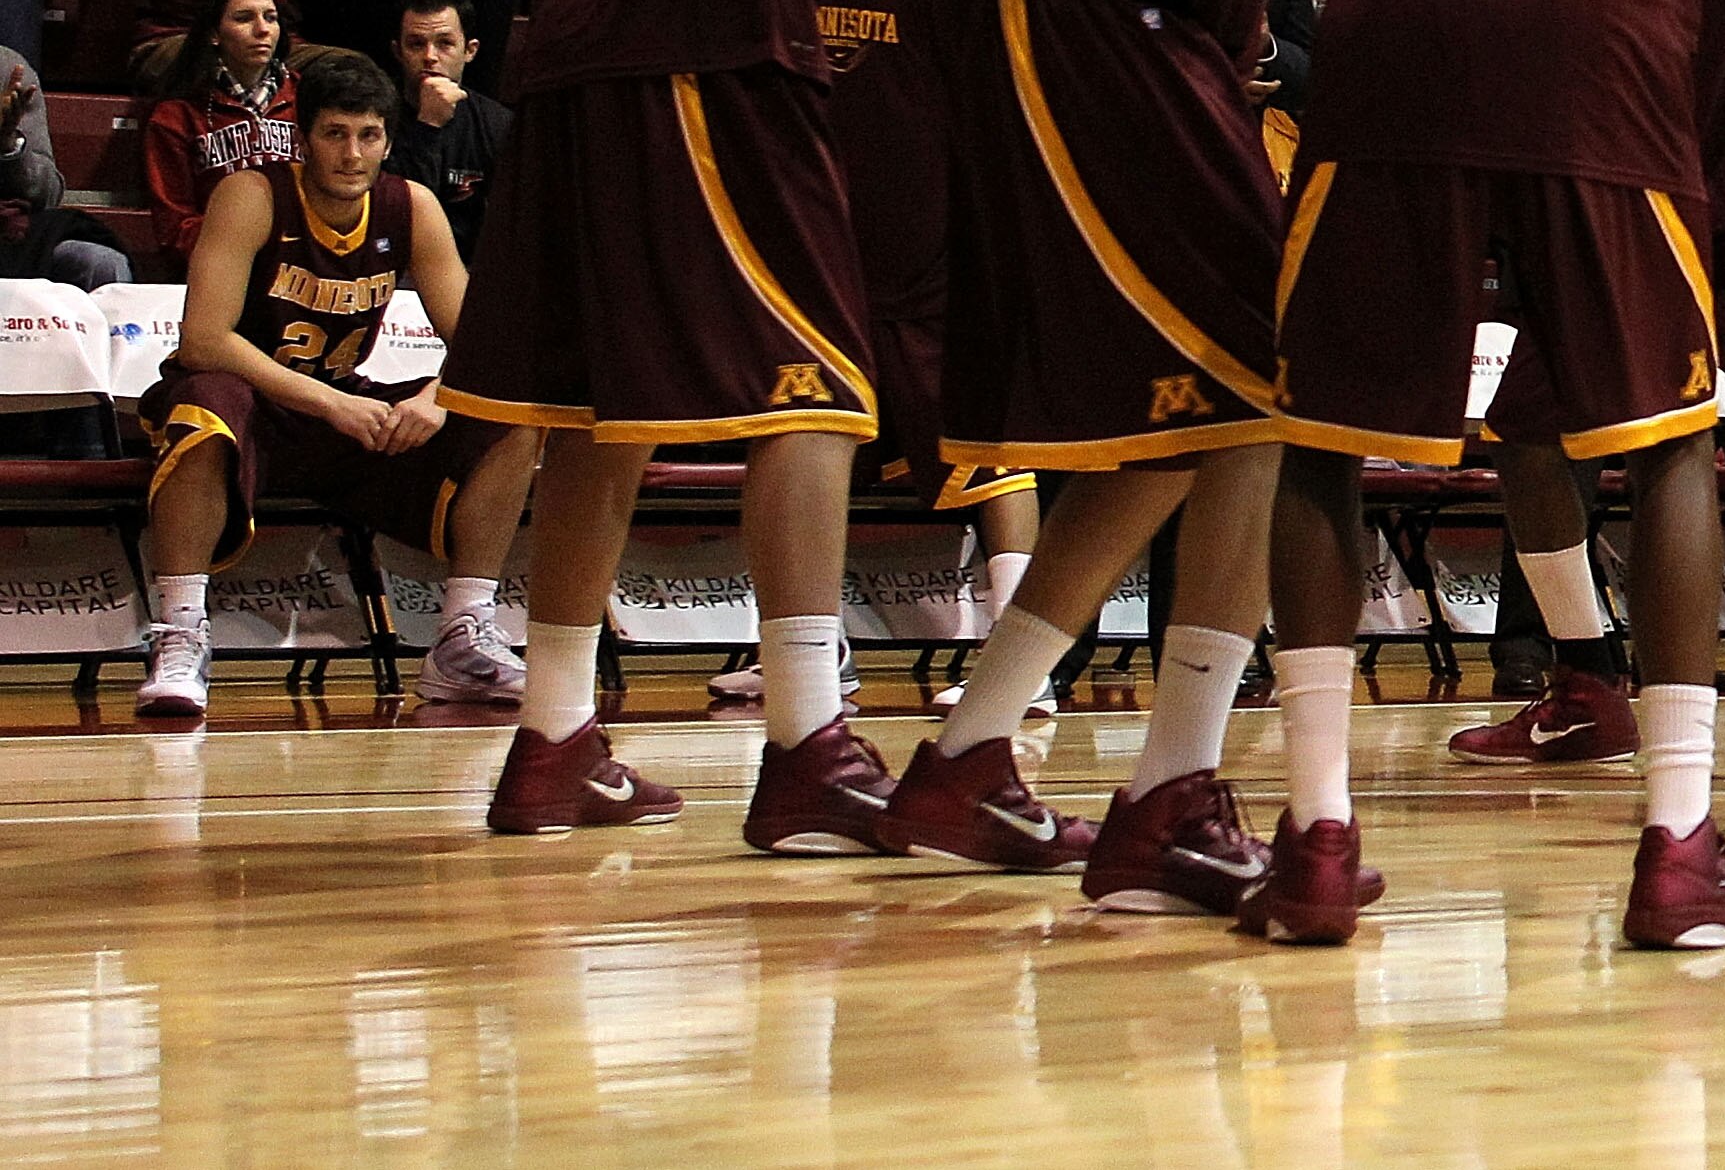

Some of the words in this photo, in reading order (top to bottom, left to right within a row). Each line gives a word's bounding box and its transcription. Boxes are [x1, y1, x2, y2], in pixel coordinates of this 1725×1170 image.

[198, 119, 252, 170] SAINT
[253, 118, 299, 156] JOSE
[273, 321, 369, 381] 24
[211, 568, 337, 597] KILDARE
[664, 573, 756, 594] KILDA
[867, 566, 978, 588] KILDARE
[217, 592, 345, 614] CAPITAL
[671, 592, 757, 610] CAPIT
[874, 585, 988, 606] CAPITAL
